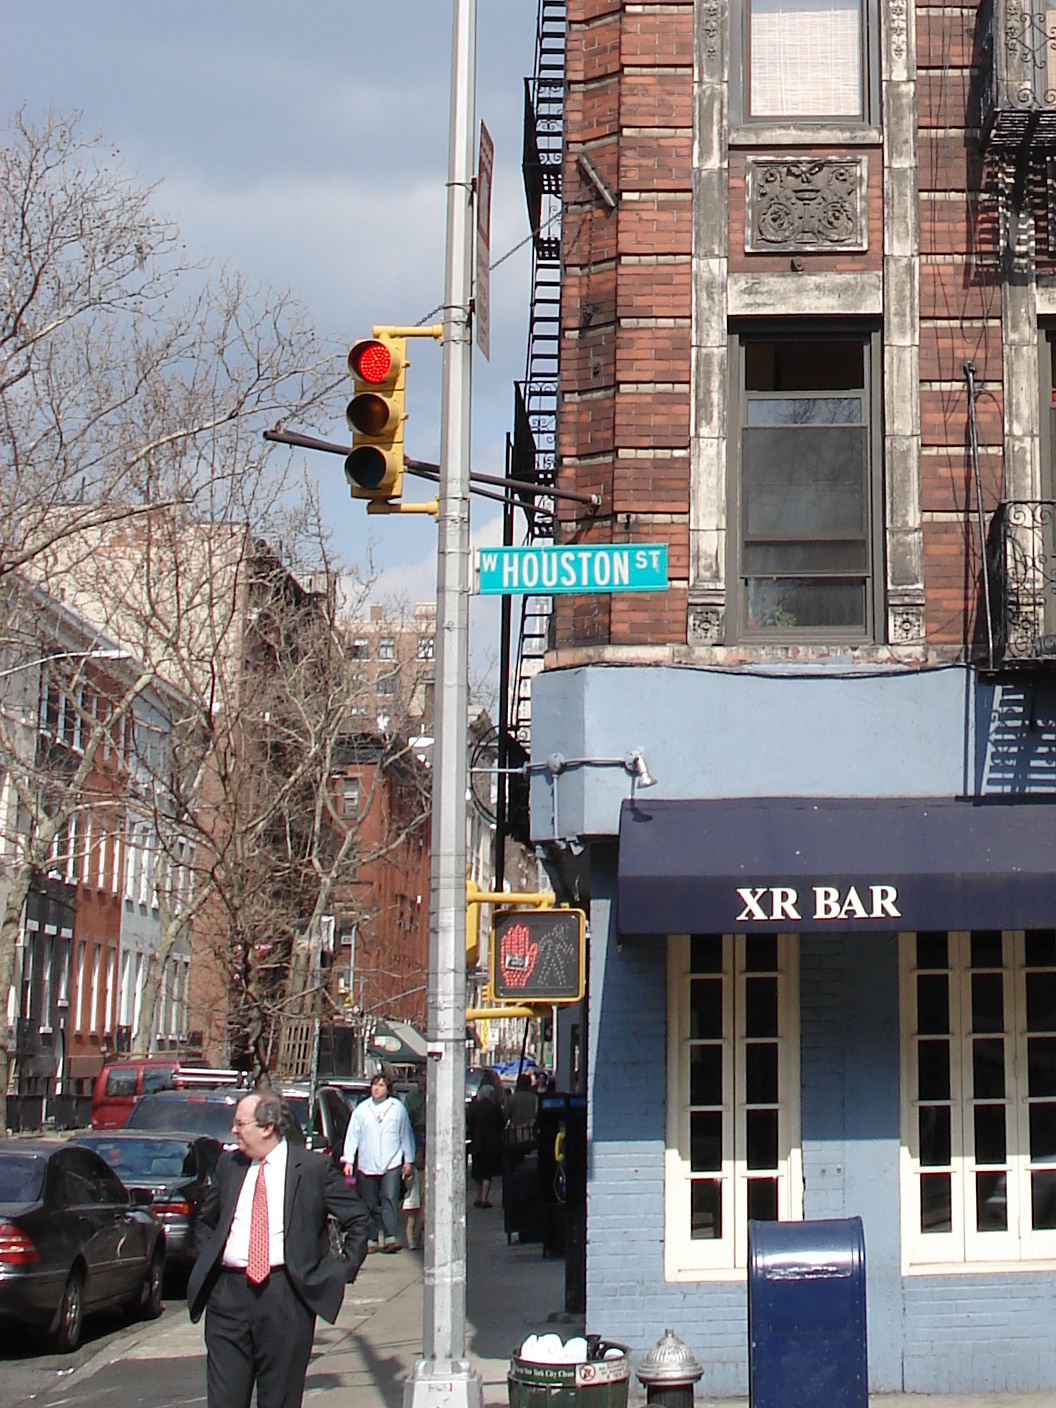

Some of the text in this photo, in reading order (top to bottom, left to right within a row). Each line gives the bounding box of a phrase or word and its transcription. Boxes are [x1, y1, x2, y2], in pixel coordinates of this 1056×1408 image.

[482, 551, 661, 588] W HOUSTON ST
[736, 885, 902, 921] XR BAR
